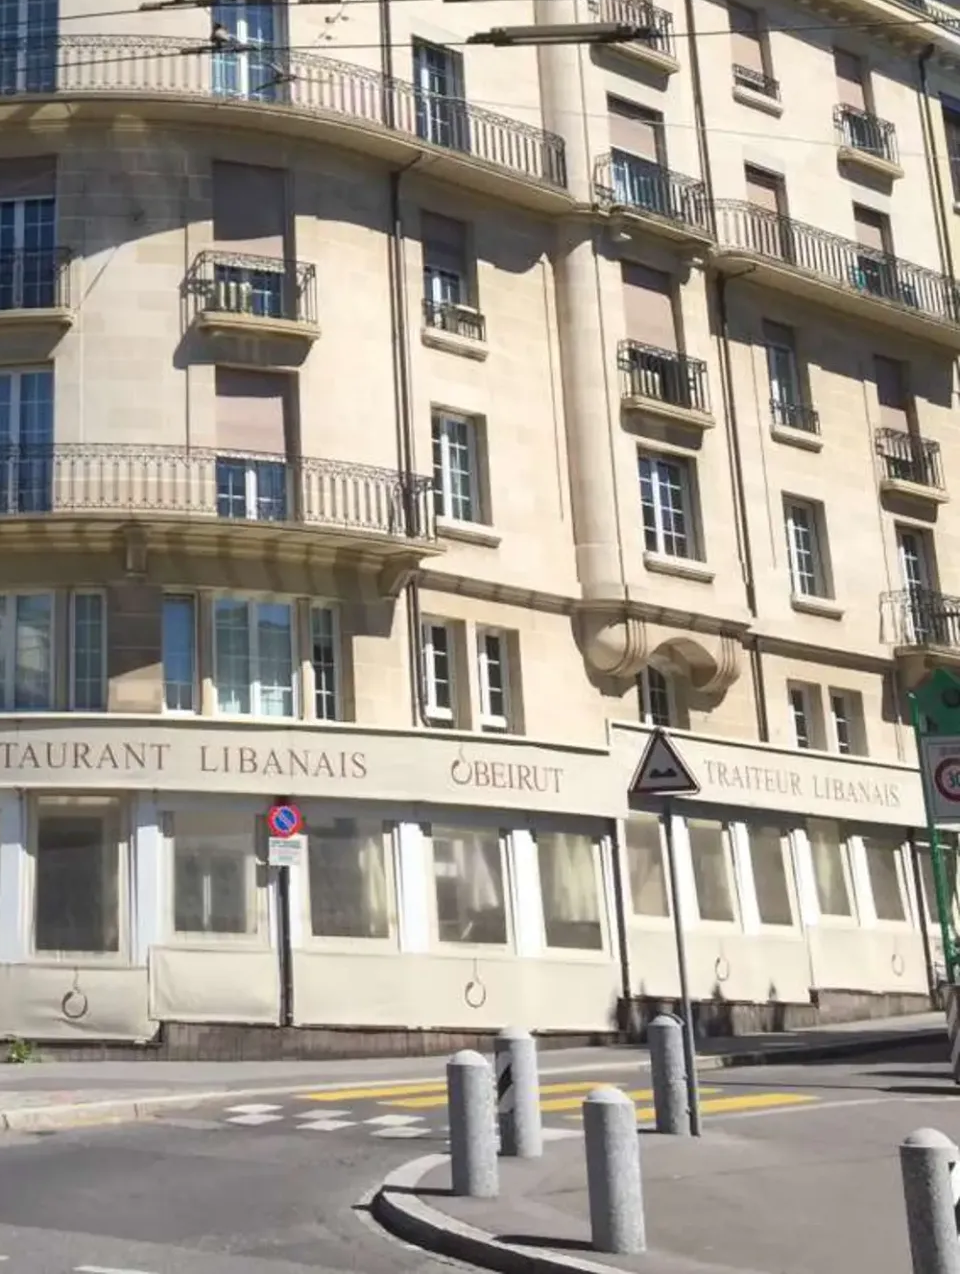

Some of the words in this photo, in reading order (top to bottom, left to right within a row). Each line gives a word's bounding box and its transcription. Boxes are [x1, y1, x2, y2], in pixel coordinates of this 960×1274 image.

[200, 745, 368, 779] LIBANAIS
[703, 759, 803, 796] TRAITEUR
[813, 775, 901, 808] LIBANAIS
